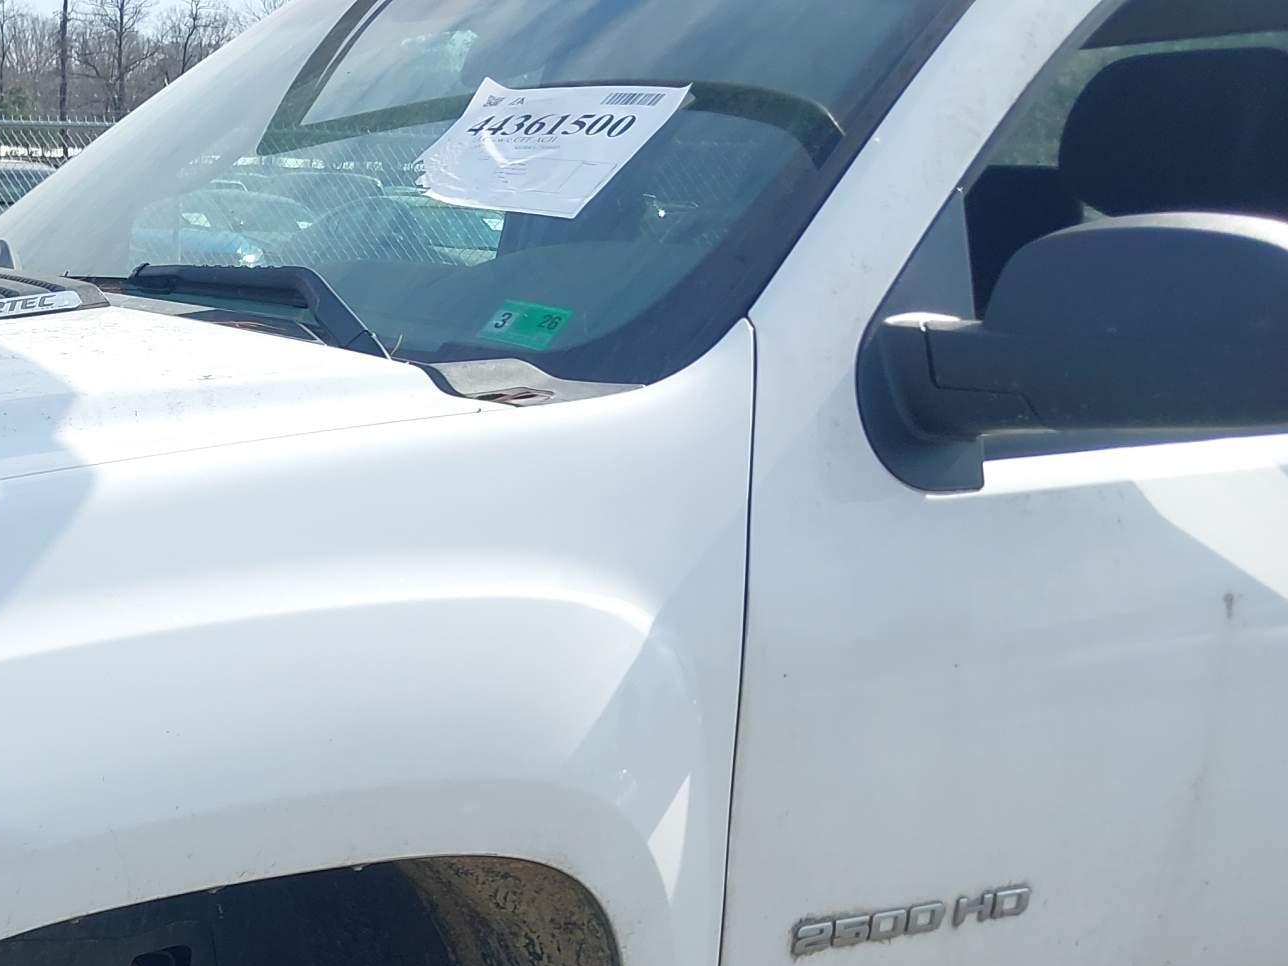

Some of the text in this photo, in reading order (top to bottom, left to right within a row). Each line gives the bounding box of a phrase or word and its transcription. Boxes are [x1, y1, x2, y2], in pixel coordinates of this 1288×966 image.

[467, 113, 637, 138] 44361500
[494, 312, 563, 331] 3 26
[792, 886, 1032, 955] 2500 HD
